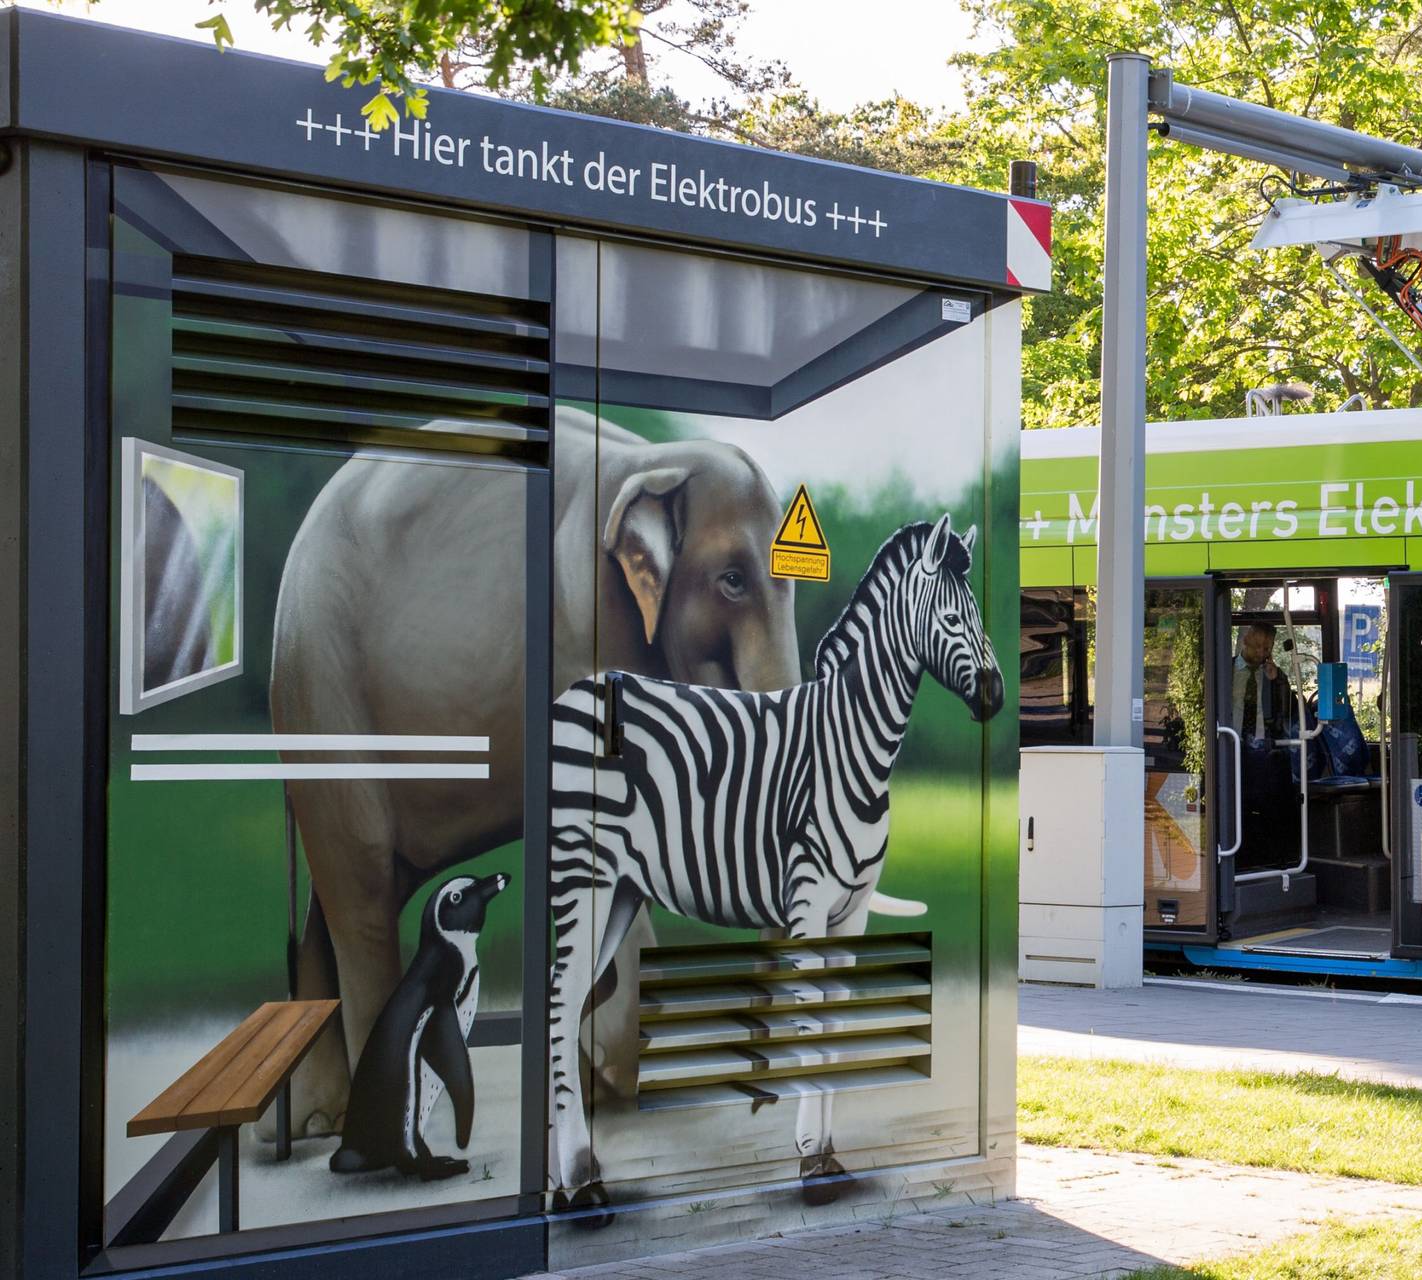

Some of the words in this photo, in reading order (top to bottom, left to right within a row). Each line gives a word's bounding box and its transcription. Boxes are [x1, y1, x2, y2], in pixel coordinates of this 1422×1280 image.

[394, 117, 471, 167] Hier
[480, 136, 574, 186] tankt
[583, 151, 641, 196] der
[650, 162, 817, 227] Elektrobus
[1067, 492, 1299, 544] Mnsters
[775, 552, 826, 567] Hochspannung
[777, 563, 824, 575] Lebensgefahr
[1350, 612, 1372, 653] P
